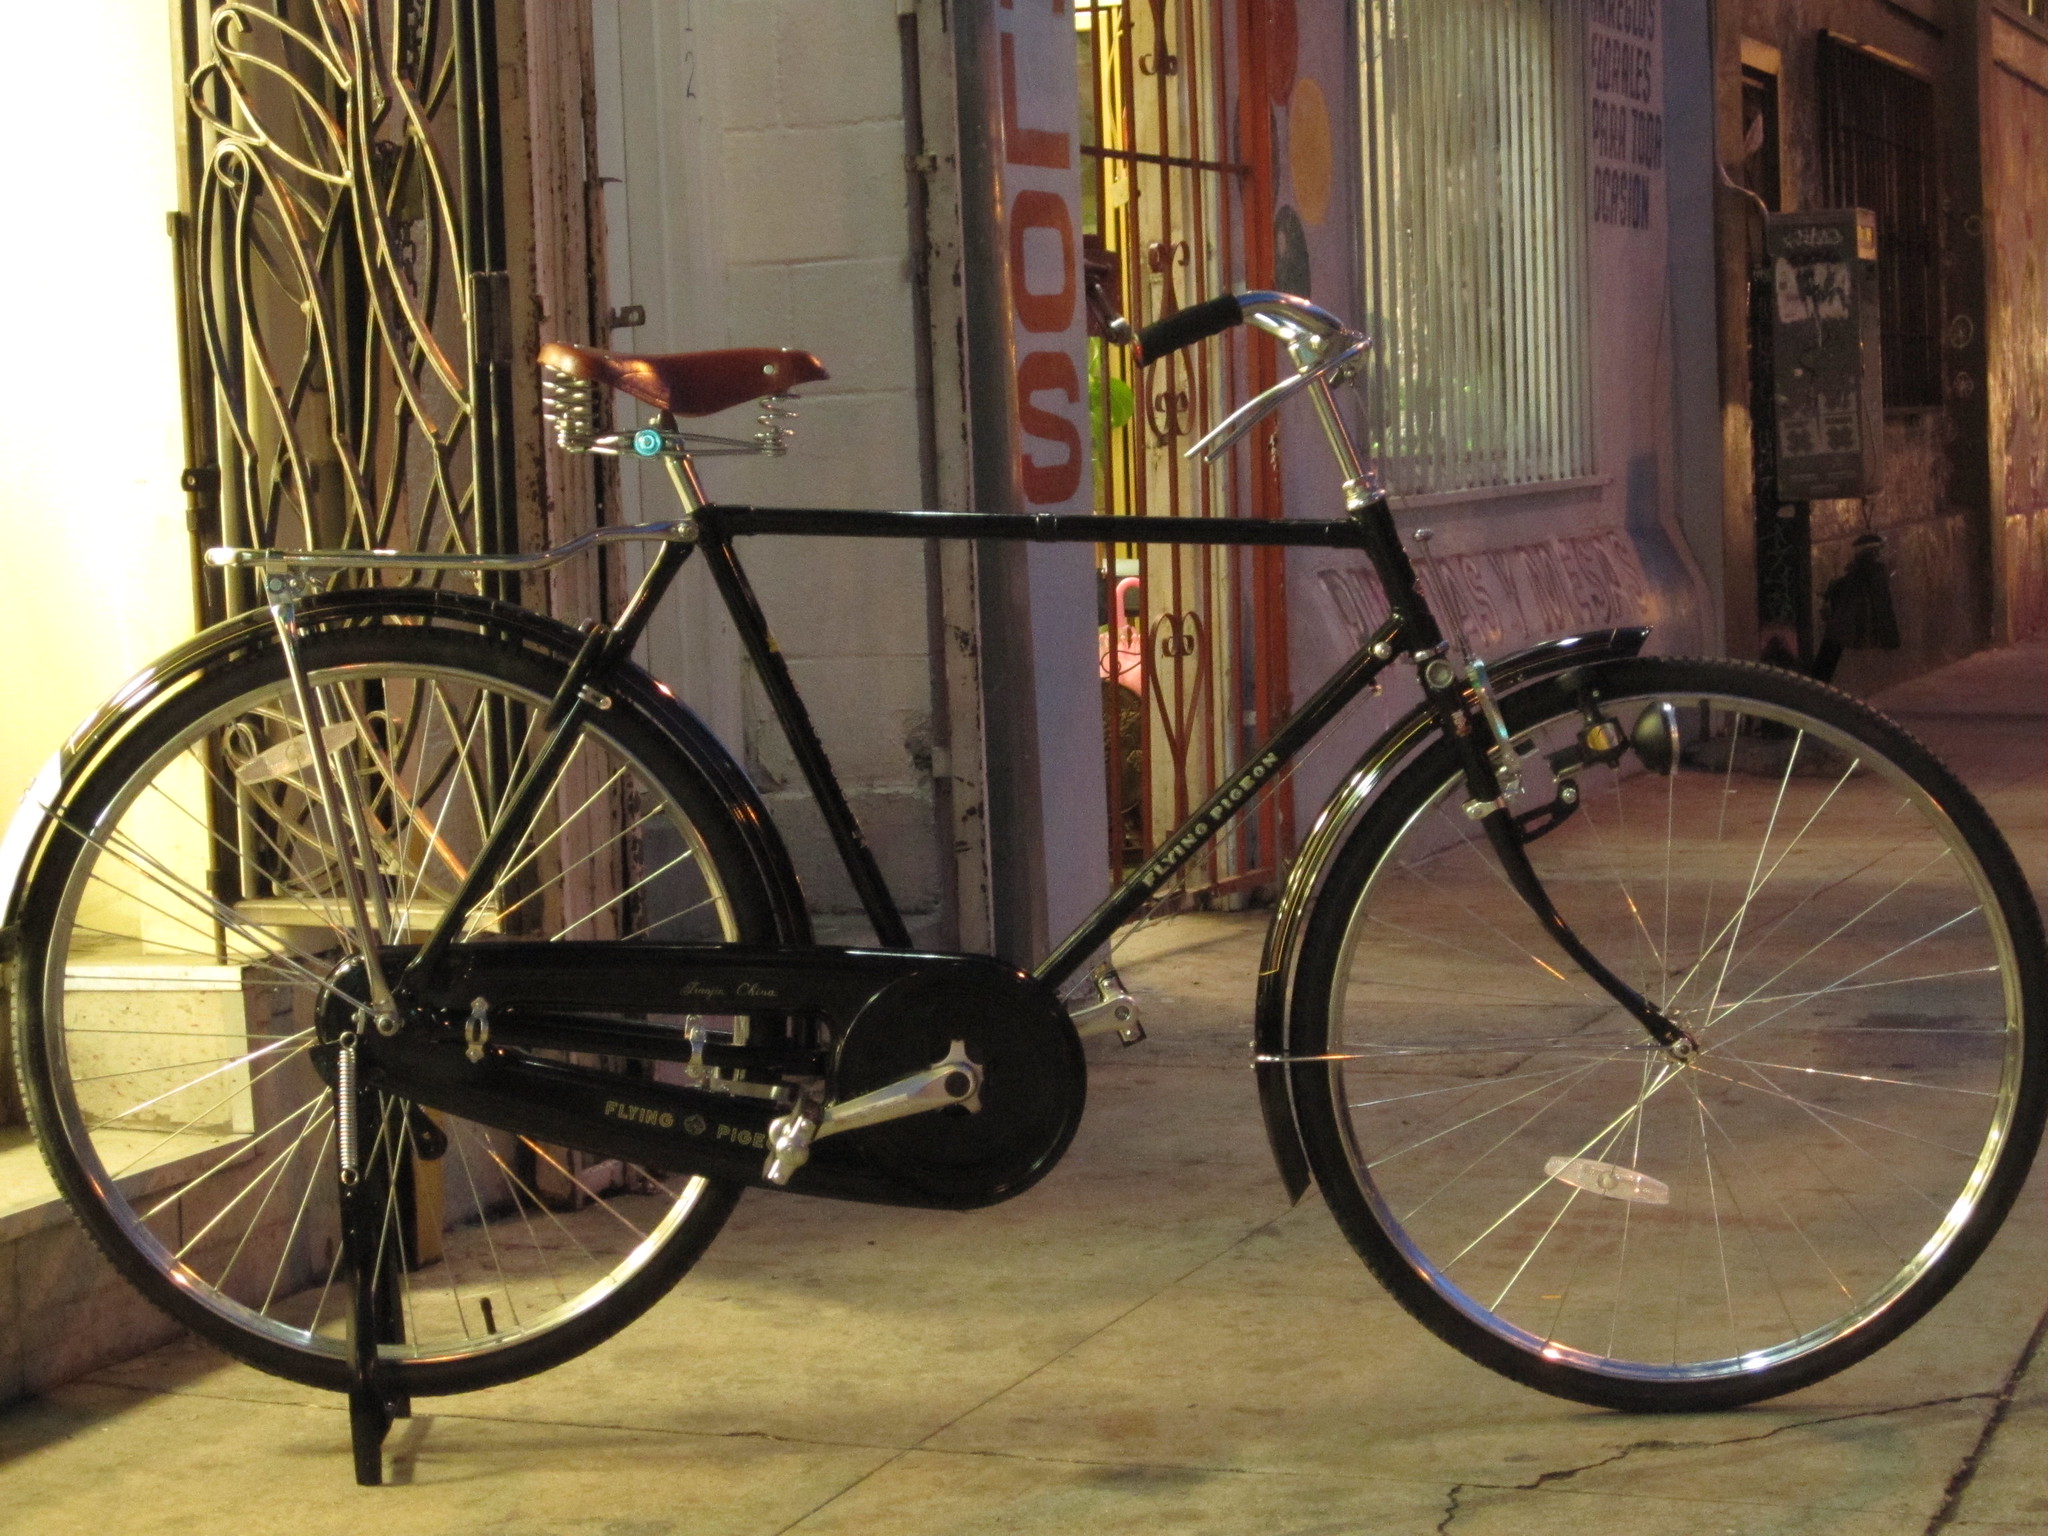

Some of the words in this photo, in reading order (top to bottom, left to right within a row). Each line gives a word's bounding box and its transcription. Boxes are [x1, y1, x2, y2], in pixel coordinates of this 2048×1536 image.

[1591, 32, 1651, 104] FLORALES
[1591, 98, 1626, 161] PARA
[1632, 108, 1662, 170] TODA
[1594, 165, 1649, 230] OCASION
[998, 0, 1082, 505] LOS
[1142, 822, 1209, 888] FLYING
[1209, 752, 1279, 821] PIGEON
[604, 1100, 675, 1128] FLYING
[715, 1124, 770, 1150] PIGE
